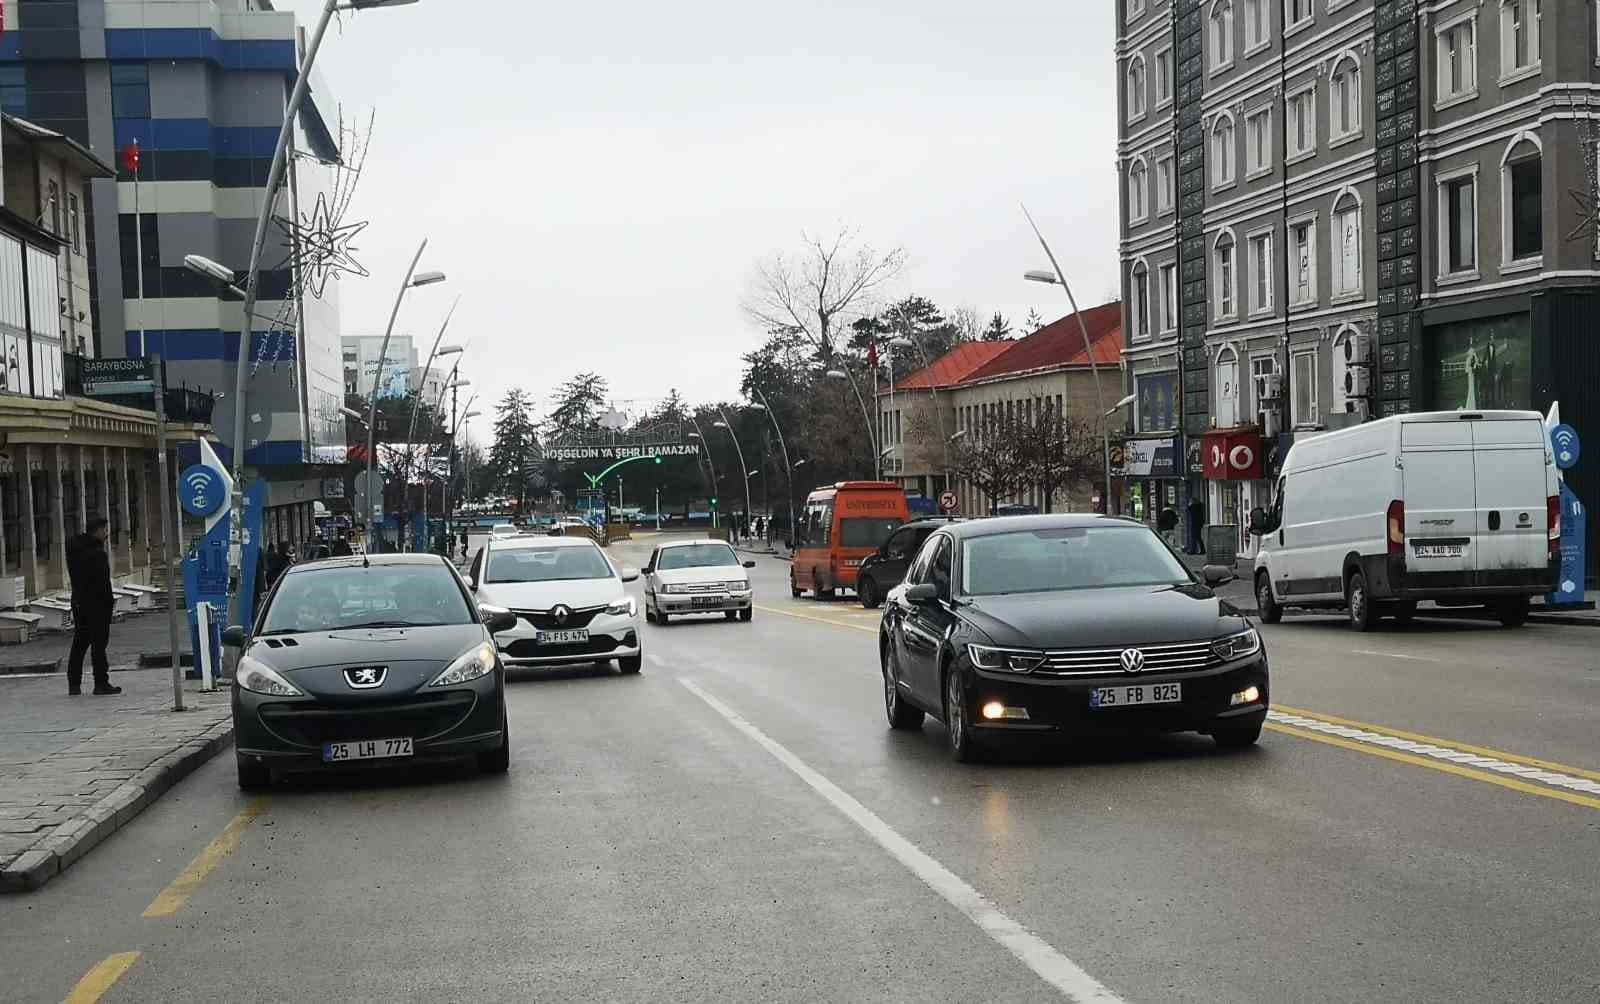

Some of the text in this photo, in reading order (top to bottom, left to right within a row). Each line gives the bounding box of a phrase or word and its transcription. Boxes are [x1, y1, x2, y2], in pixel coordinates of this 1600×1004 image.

[84, 361, 145, 371] SARAYBOSNA
[542, 446, 599, 460] HOŞGELDİN
[601, 448, 613, 458] YA
[648, 445, 699, 457] RAMAZAN
[572, 631, 587, 641] 474
[1099, 684, 1179, 704] 25 FB 825
[332, 739, 411, 759] 25 LH 772
